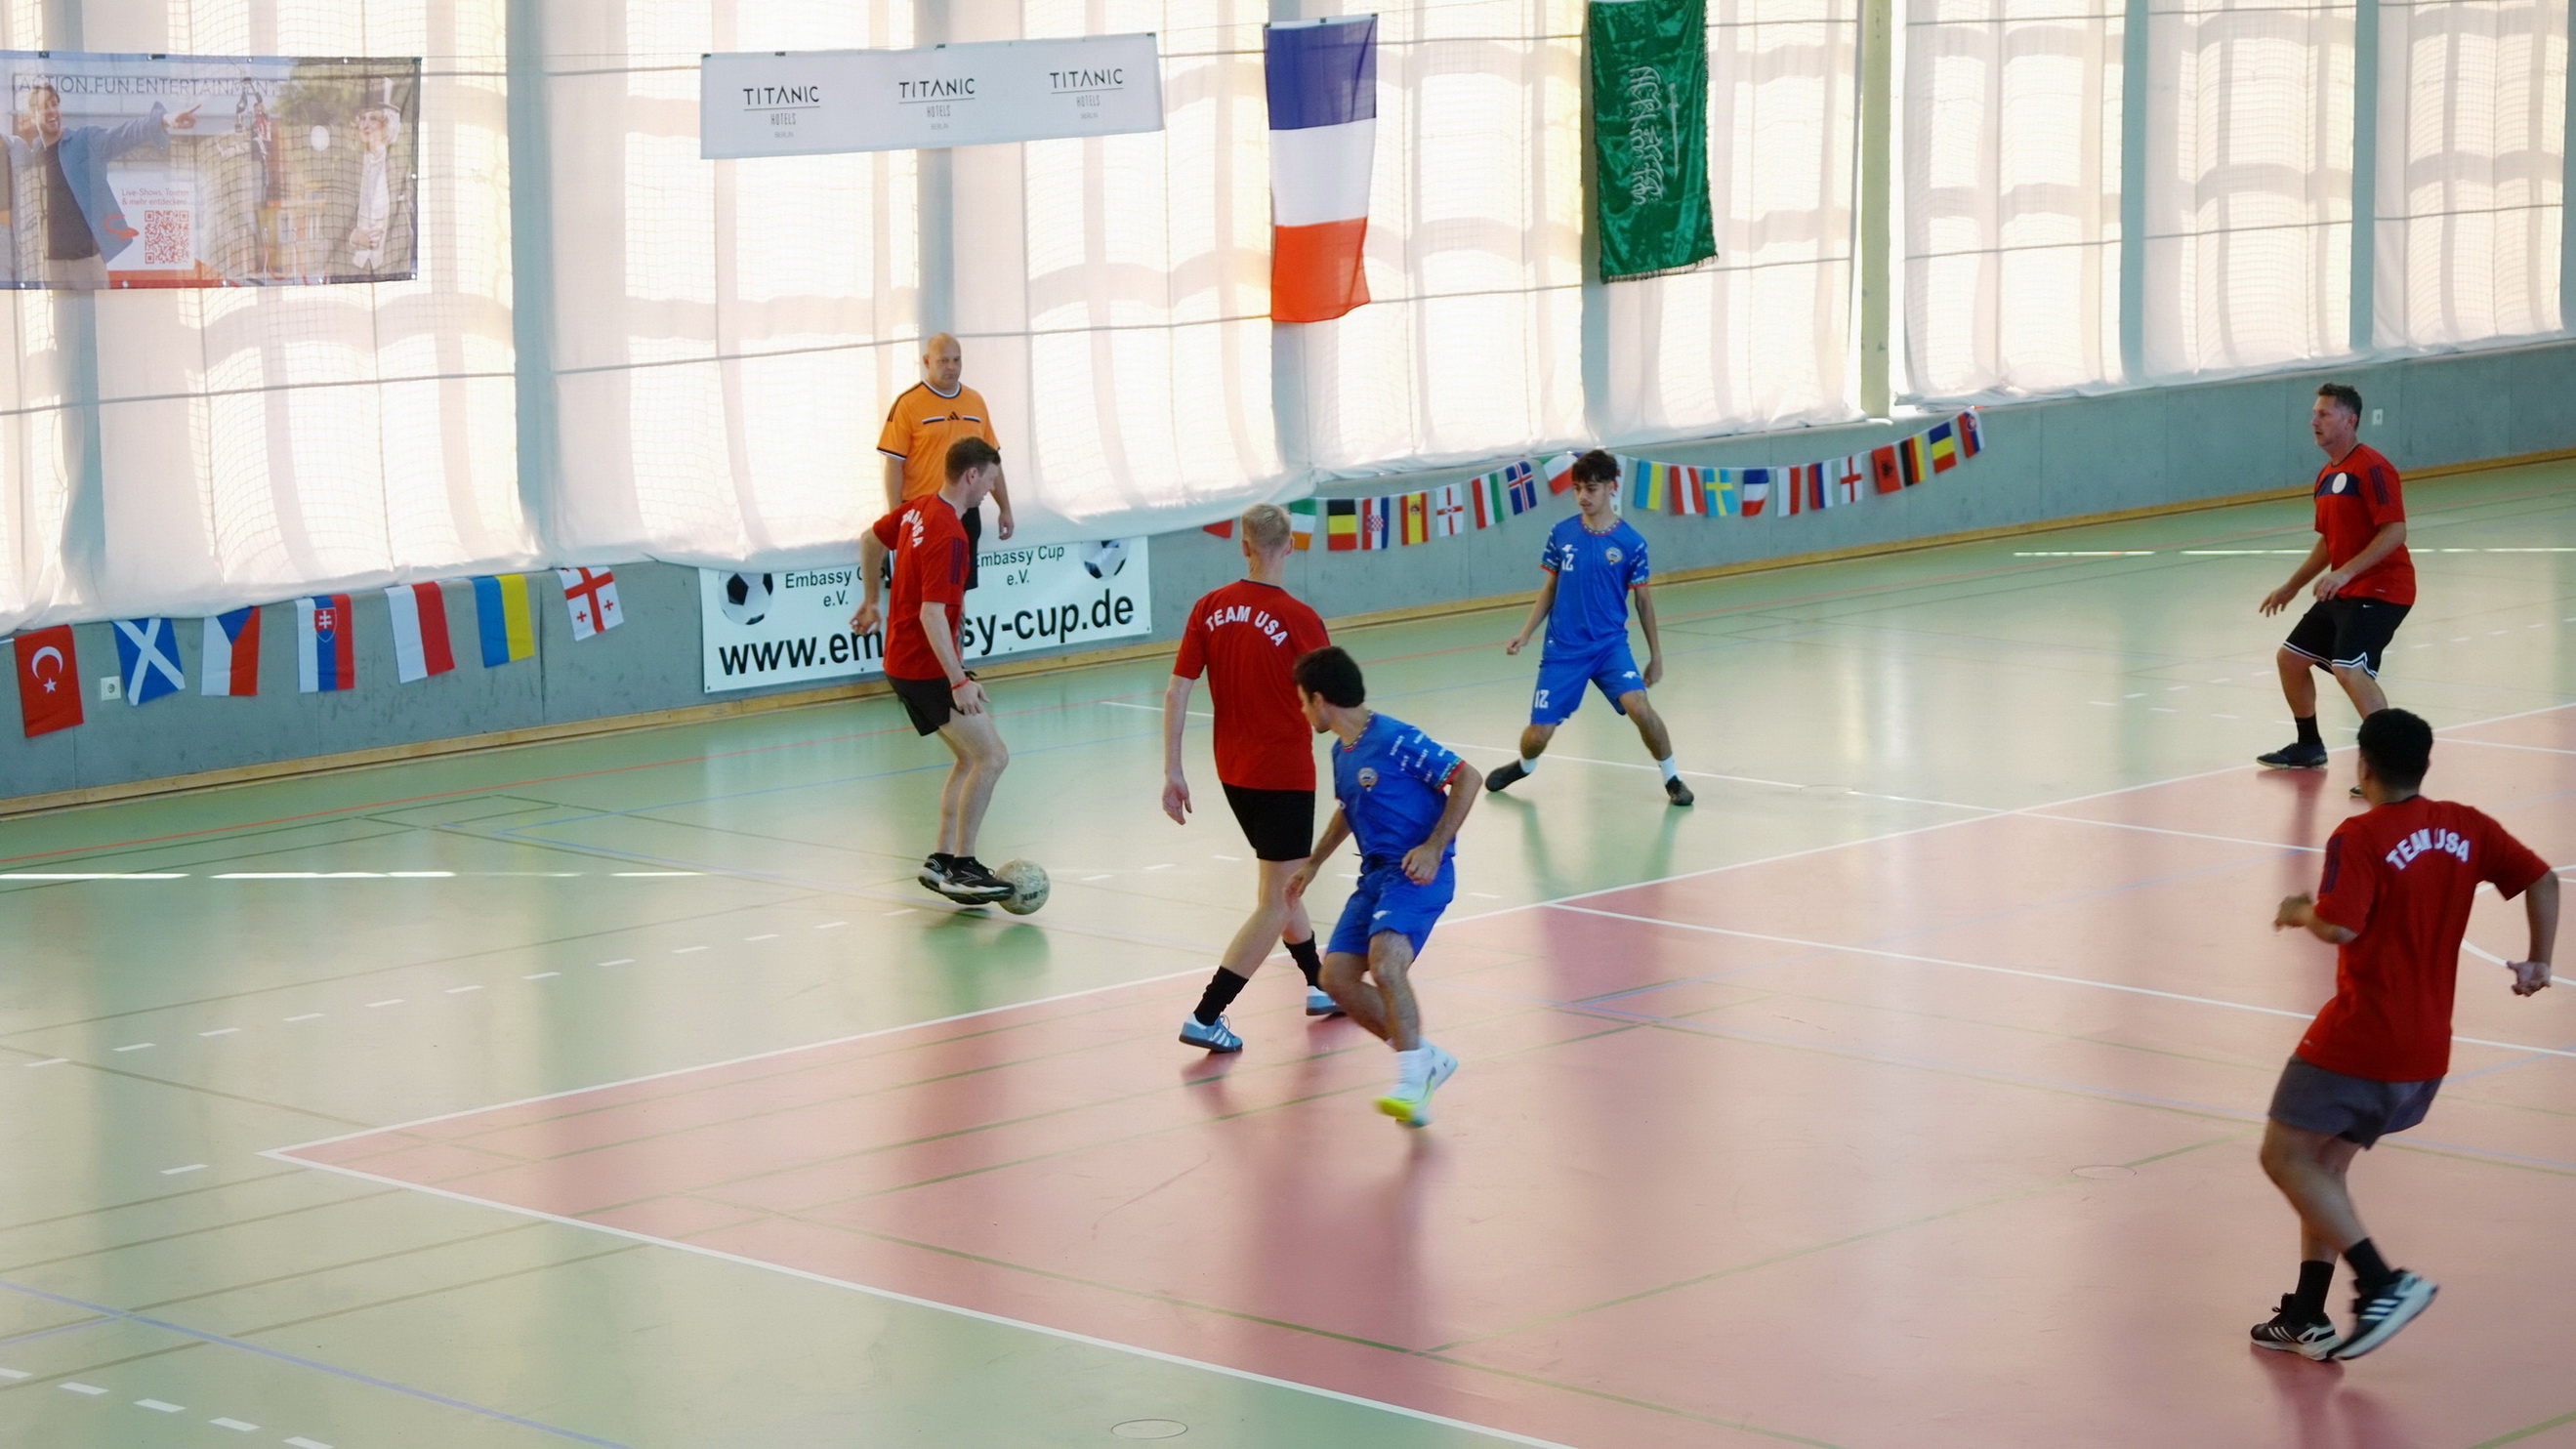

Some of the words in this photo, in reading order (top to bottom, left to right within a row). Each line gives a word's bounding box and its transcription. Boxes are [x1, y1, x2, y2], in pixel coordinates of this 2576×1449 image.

[1050, 68, 1123, 89] TITANIC
[742, 85, 819, 105] TITANIC
[898, 78, 975, 99] TITANIC
[927, 104, 951, 117] HOTELS
[1076, 95, 1101, 107] HOTELS
[770, 112, 796, 125] HOTELS
[1038, 545, 1064, 561] Cup
[1561, 553, 1574, 571] 12
[785, 570, 852, 589] Embassy
[1007, 568, 1030, 586] e.V.
[823, 590, 849, 606] e.V.
[719, 588, 1134, 676] www.emsy-cup.de
[1205, 605, 1251, 632] TEAM
[1254, 610, 1288, 646] USA
[1534, 689, 1550, 709] 12
[2385, 828, 2432, 871] TEAM
[2433, 828, 2470, 863] USA
